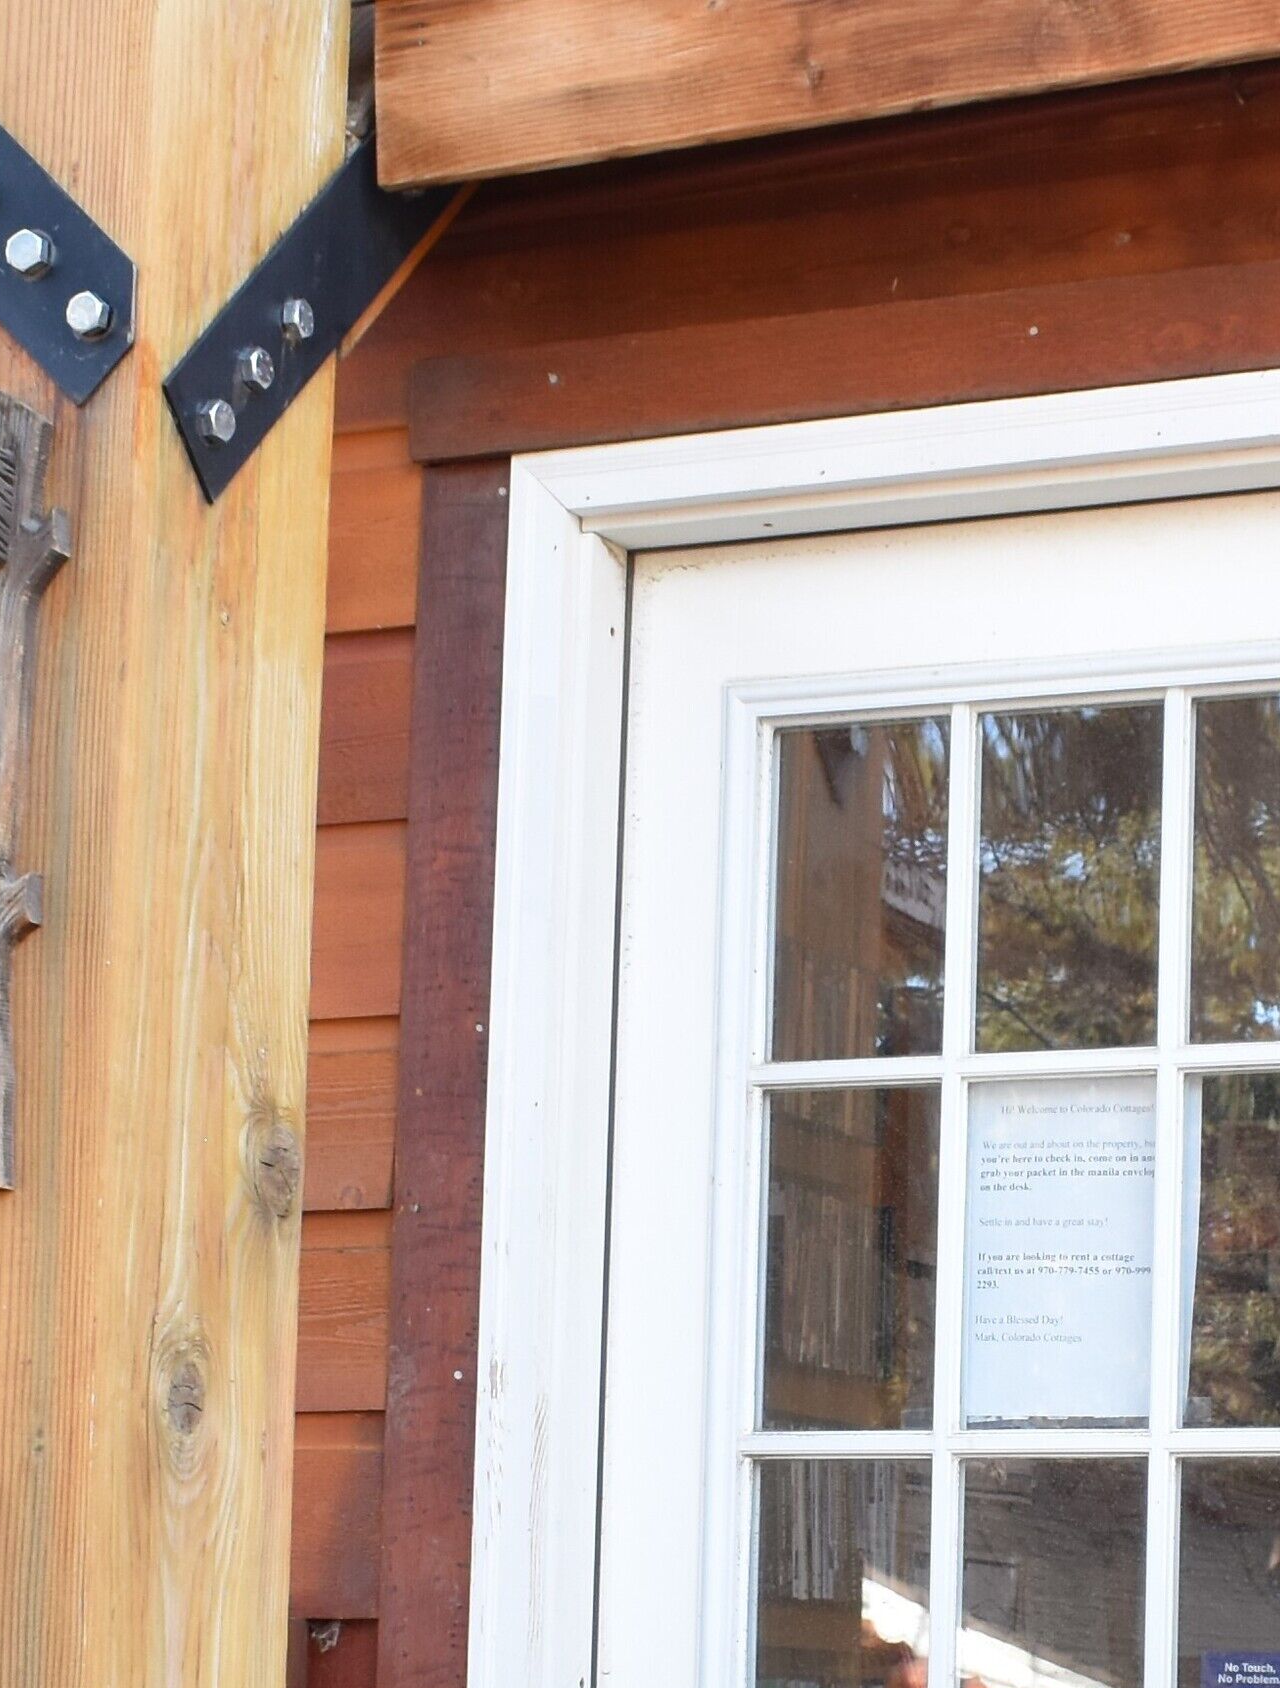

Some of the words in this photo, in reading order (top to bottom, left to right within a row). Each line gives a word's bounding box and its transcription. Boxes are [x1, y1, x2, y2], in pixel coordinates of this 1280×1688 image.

[1017, 1104, 1057, 1114] Welcome
[1059, 1105, 1069, 1113] to
[1070, 1104, 1110, 1113] Colorado
[982, 1140, 996, 1149] We
[1013, 1141, 1027, 1149] out
[1030, 1139, 1045, 1149] and
[1046, 1139, 1070, 1149] about
[1086, 1139, 1100, 1148] the
[980, 1155, 1010, 1165] you're
[1012, 1154, 1032, 1163] here
[1034, 1155, 1043, 1163] to
[1045, 1154, 1071, 1163] check
[1129, 1154, 1139, 1162] in
[980, 1168, 1001, 1179] grab
[1003, 1170, 1024, 1179] your
[1026, 1168, 1056, 1179] packet
[1058, 1168, 1068, 1176] in
[1070, 1168, 1085, 1176] the
[1087, 1168, 1120, 1176] manila
[979, 1184, 991, 1192] on
[993, 1182, 1006, 1191] the
[1009, 1182, 1032, 1191] desk.
[978, 1217, 1003, 1227] Settle
[1015, 1217, 1030, 1226] and
[1033, 1217, 1053, 1226] have
[1062, 1218, 1084, 1228] great
[1087, 1217, 1108, 1228] stay!
[978, 1252, 987, 1261] If
[988, 1253, 1003, 1263] you
[1023, 1252, 1056, 1263] looking
[1059, 1253, 1068, 1261] to
[1071, 1253, 1090, 1261] rent
[1101, 1253, 1135, 1262] cottage
[1038, 1266, 1100, 1275] 970-779-7455
[975, 1314, 997, 1325] Have
[1006, 1314, 1039, 1324] Blessed
[1001, 1332, 1042, 1343] Colorado
[1043, 1333, 1083, 1344] Cottages
[1224, 1662, 1240, 1673] No
[1243, 1662, 1276, 1674] Touch,
[1217, 1674, 1234, 1684] No
